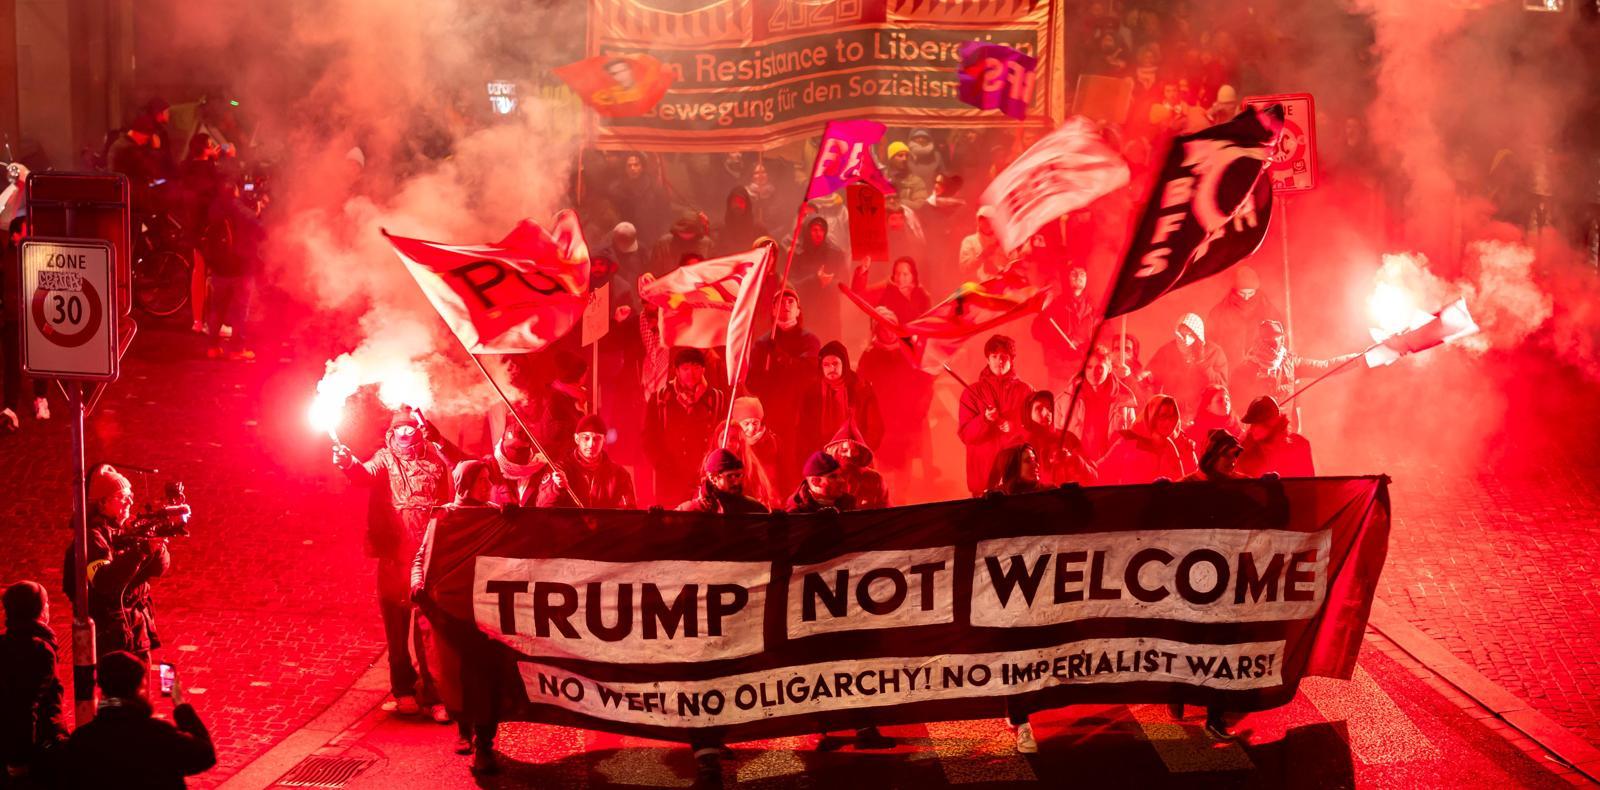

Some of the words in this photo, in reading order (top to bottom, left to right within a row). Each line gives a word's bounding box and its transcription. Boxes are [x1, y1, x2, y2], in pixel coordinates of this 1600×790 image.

[696, 45, 829, 82] Resistance
[836, 38, 864, 64] to
[874, 32, 1034, 62] Libern
[643, 95, 774, 125] ewegung
[778, 88, 798, 112] für
[803, 81, 841, 104] den
[850, 73, 961, 97] Sozialism
[47, 253, 87, 270] ZONE
[52, 294, 83, 325] 30
[485, 579, 749, 642] TRUMP
[802, 561, 945, 622] NOT
[984, 548, 1318, 610] WELCOME
[538, 673, 585, 702] NO
[596, 682, 667, 718] WEF!
[677, 690, 726, 717] NO
[735, 666, 932, 711] OLIGARCHY!
[942, 664, 992, 689] NO
[1002, 648, 1178, 686] IMPERIALIST
[1185, 653, 1275, 681] WARS!
